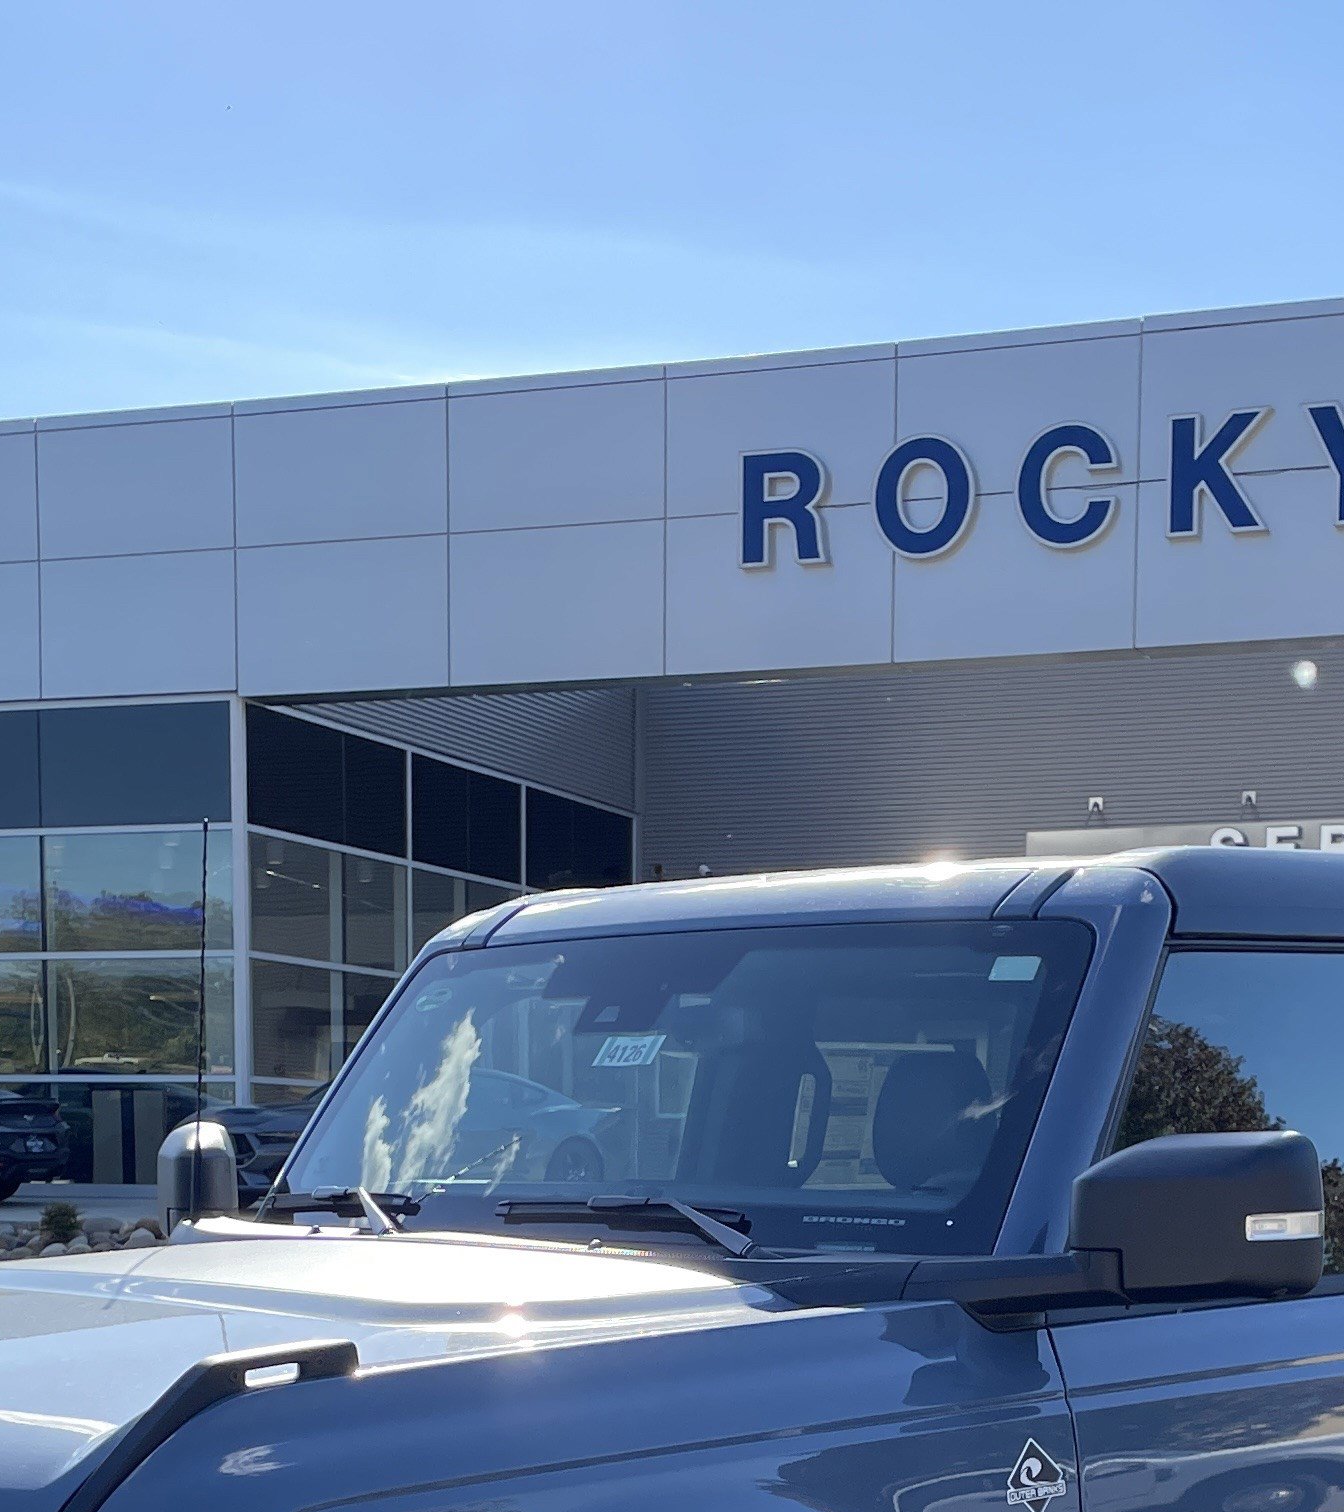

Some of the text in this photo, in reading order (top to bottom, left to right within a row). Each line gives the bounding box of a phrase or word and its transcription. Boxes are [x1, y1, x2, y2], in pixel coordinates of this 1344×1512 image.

[606, 1044, 647, 1063] 4126
[1010, 1483, 1064, 1502] OUTER BANKS
